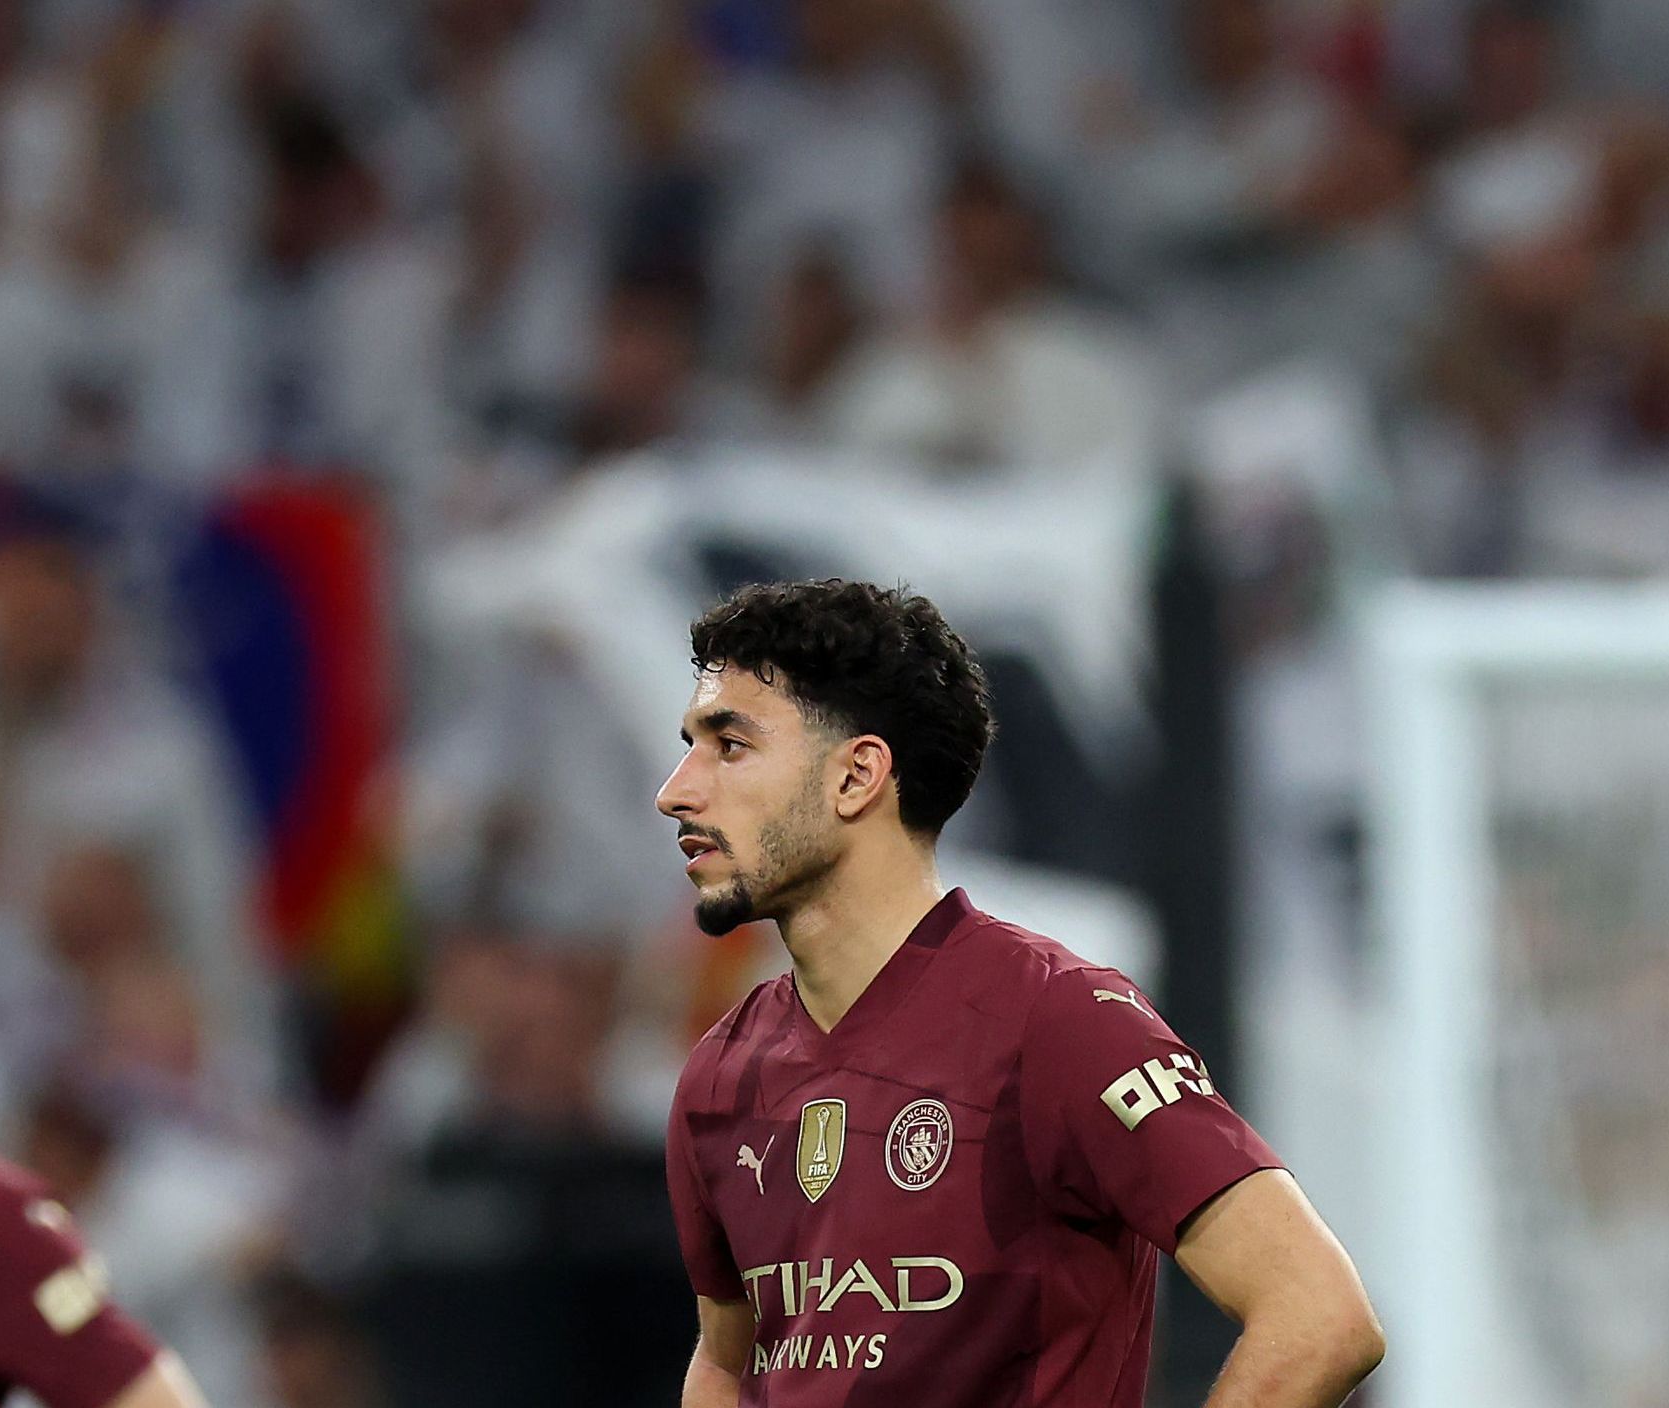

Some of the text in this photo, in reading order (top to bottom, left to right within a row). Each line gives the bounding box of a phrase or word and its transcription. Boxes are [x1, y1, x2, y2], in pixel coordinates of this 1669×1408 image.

[895, 1106, 948, 1136] MANCHESTER
[807, 1162, 829, 1177] FIFA
[906, 1173, 928, 1184] CITY
[741, 1256, 964, 1323] TIHAD
[753, 1333, 887, 1375] AIRWAYS
